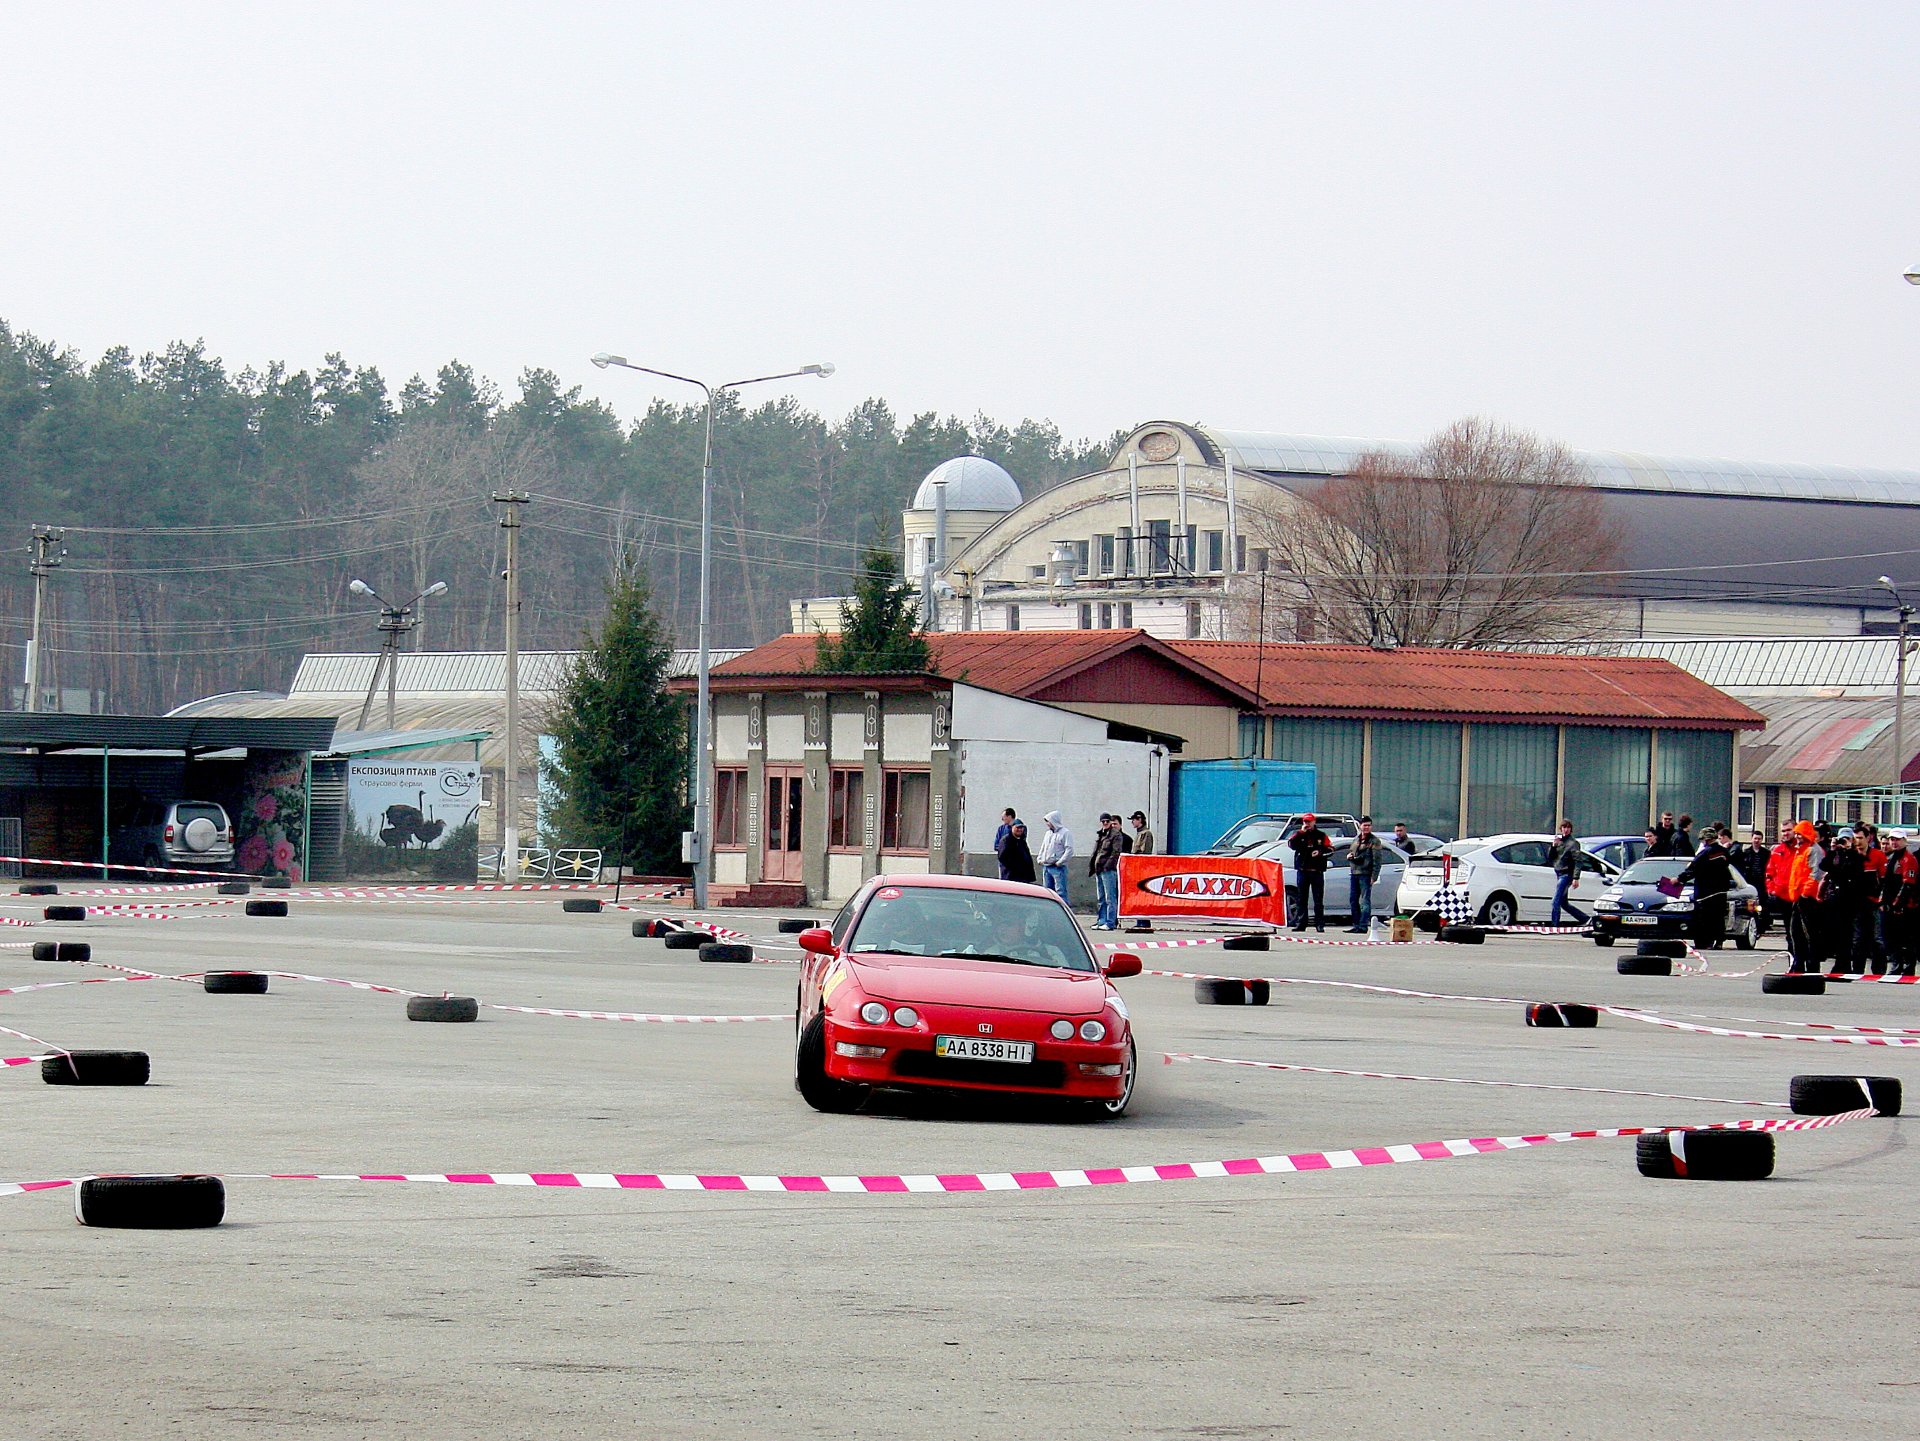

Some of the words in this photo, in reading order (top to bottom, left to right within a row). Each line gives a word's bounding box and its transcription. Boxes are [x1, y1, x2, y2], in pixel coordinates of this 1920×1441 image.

[351, 766, 405, 776] ЕКСПОЗИЦІЯ
[406, 767, 437, 776] ПТАХІВ
[1161, 877, 1253, 896] MAXXIS
[946, 1040, 967, 1055] AA
[971, 1042, 1004, 1058] 8338
[1007, 1045, 1025, 1060] HI
